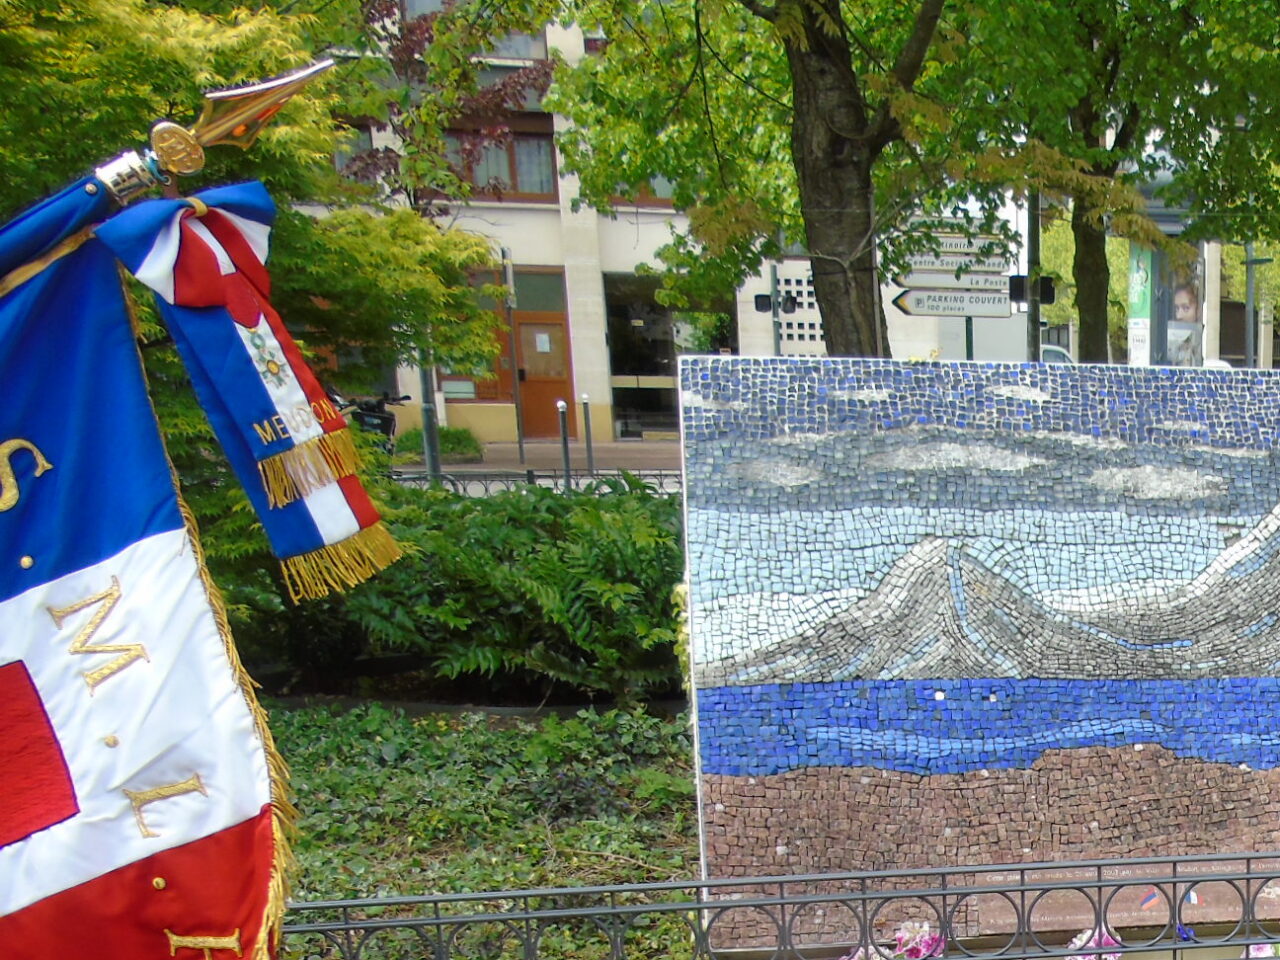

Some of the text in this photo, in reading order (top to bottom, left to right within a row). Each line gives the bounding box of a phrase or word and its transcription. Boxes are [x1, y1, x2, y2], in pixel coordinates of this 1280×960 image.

[983, 278, 1008, 287] Poste
[926, 294, 965, 304] PARKING
[969, 296, 1008, 305] COUVERT
